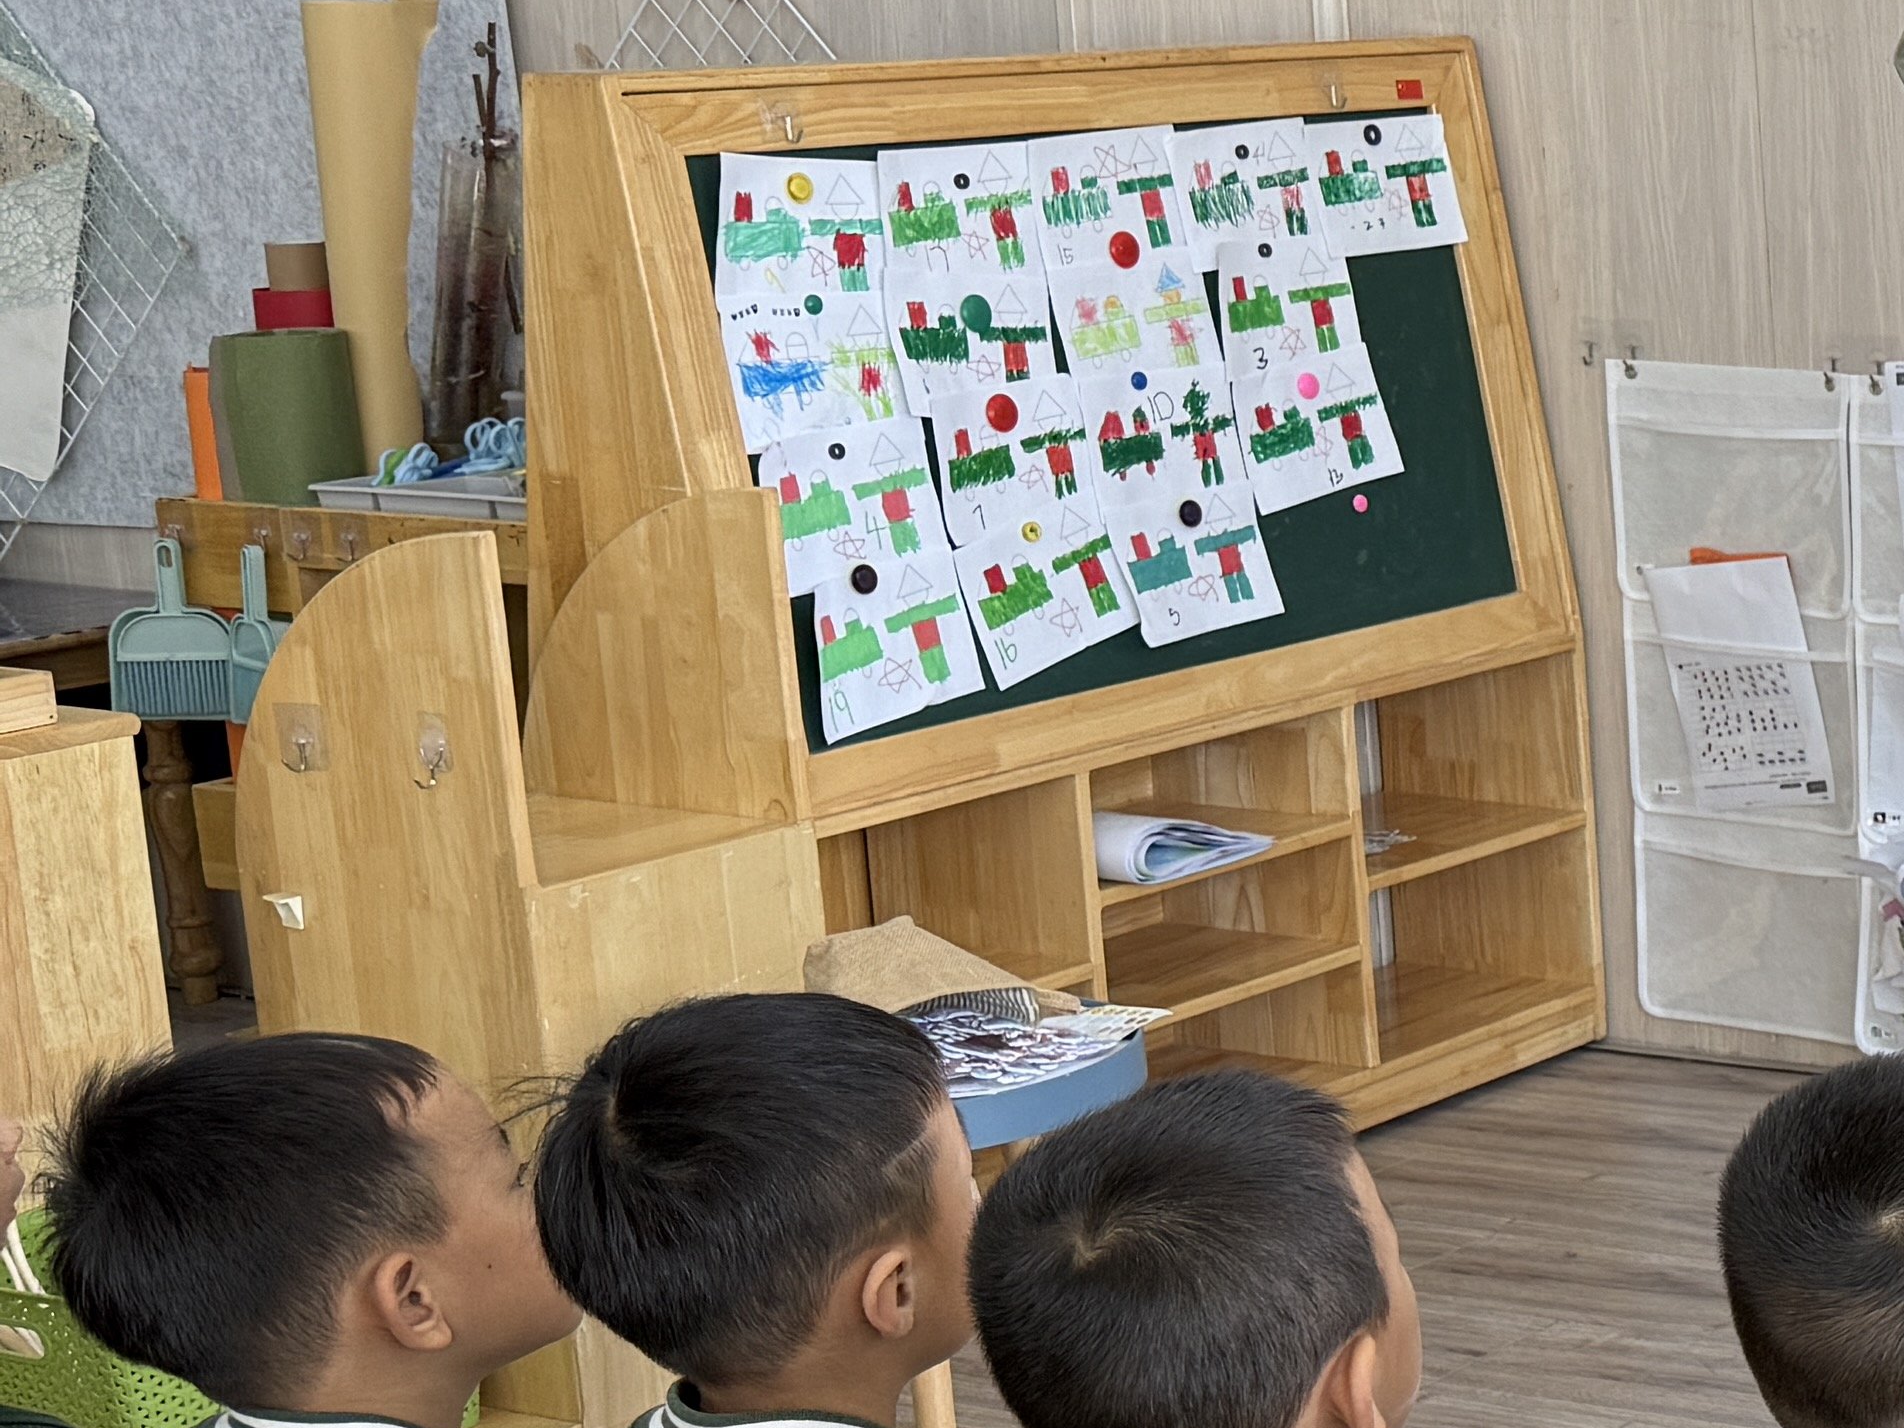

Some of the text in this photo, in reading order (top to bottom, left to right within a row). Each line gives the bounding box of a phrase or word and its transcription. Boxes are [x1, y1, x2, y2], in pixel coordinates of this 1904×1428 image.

[1057, 243, 1074, 266] 15
[1253, 347, 1269, 370] 3
[865, 511, 888, 550] 4
[994, 637, 1018, 671] 16
[827, 689, 856, 734] 19
